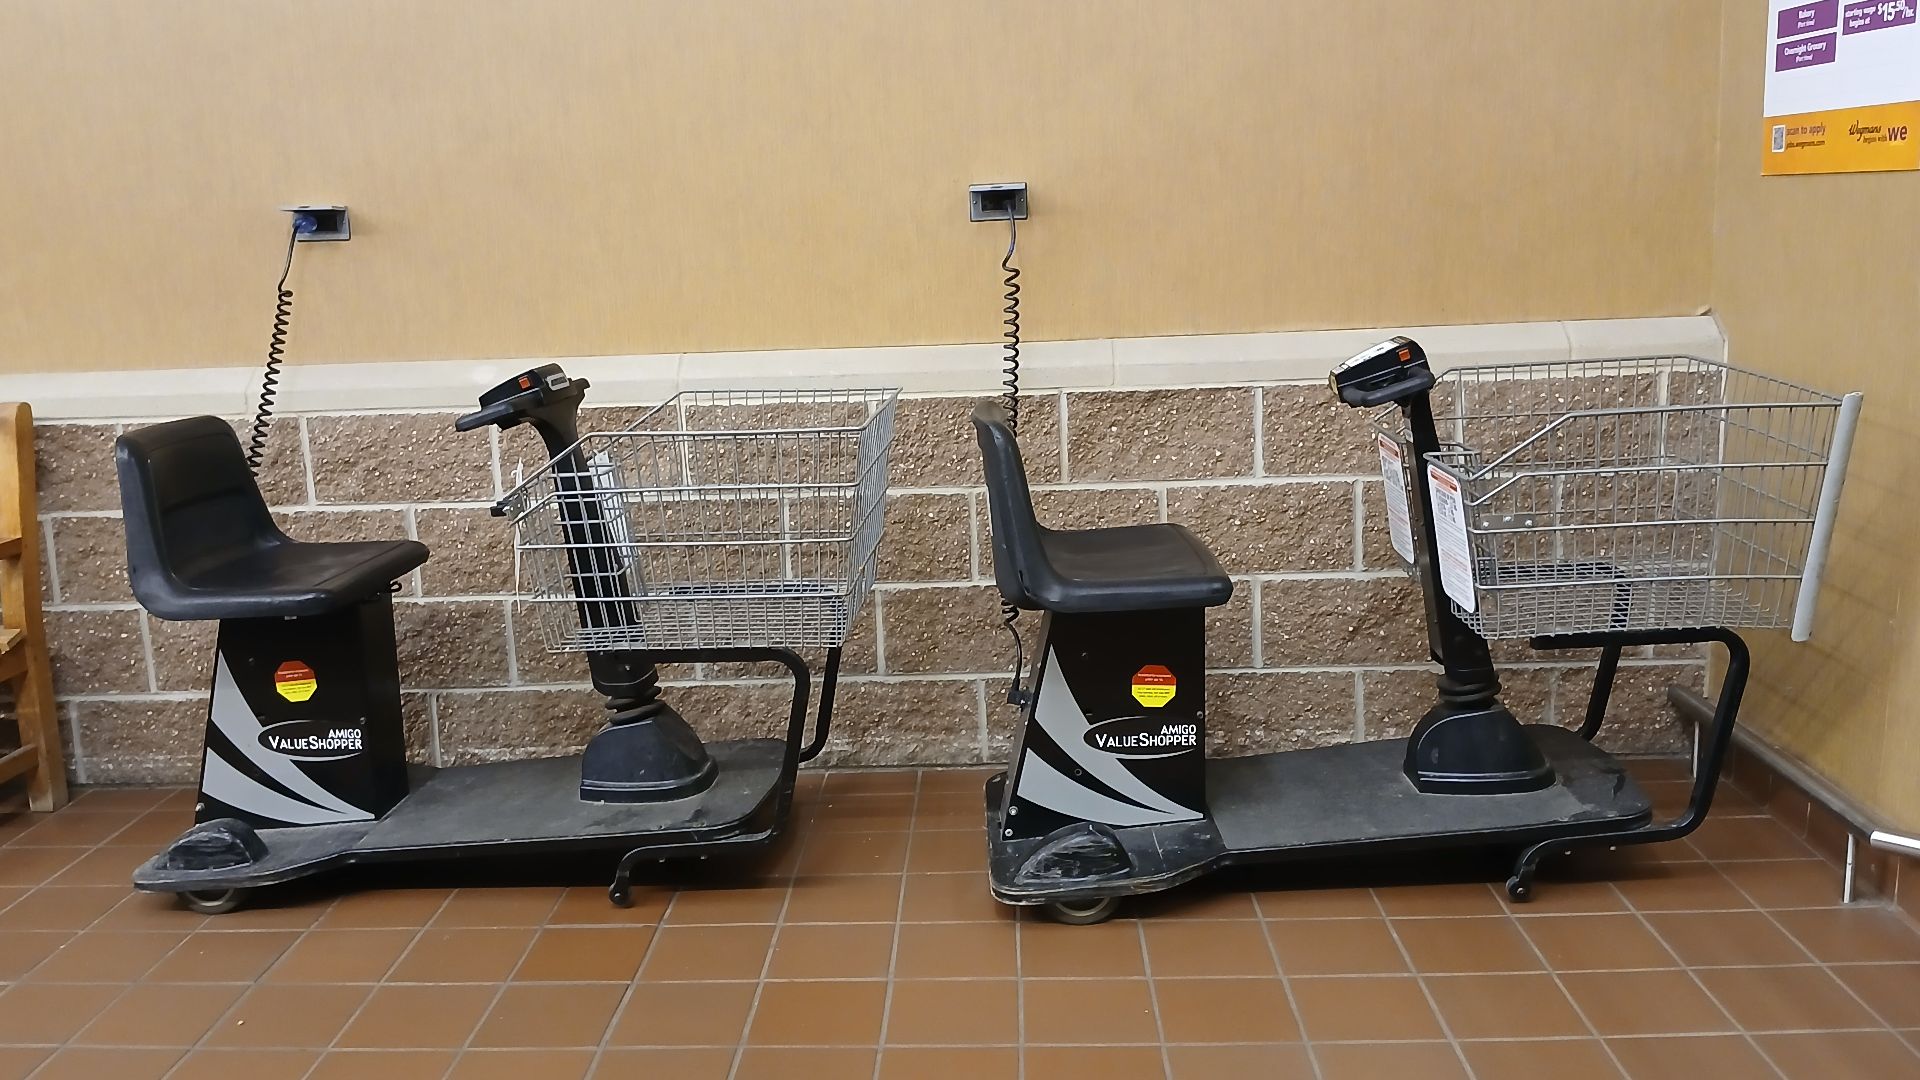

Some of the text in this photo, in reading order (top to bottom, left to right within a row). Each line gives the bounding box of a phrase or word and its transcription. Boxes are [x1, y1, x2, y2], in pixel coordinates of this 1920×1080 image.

[1798, 9, 1815, 19] Bakery
[1807, 42, 1826, 51] Grocery
[1801, 126, 1807, 134] to
[1809, 122, 1825, 136] apply
[1848, 120, 1881, 141] Wegmans
[1887, 126, 1907, 141] we
[328, 728, 361, 739] AMIGO
[1160, 724, 1197, 735] AMIGO
